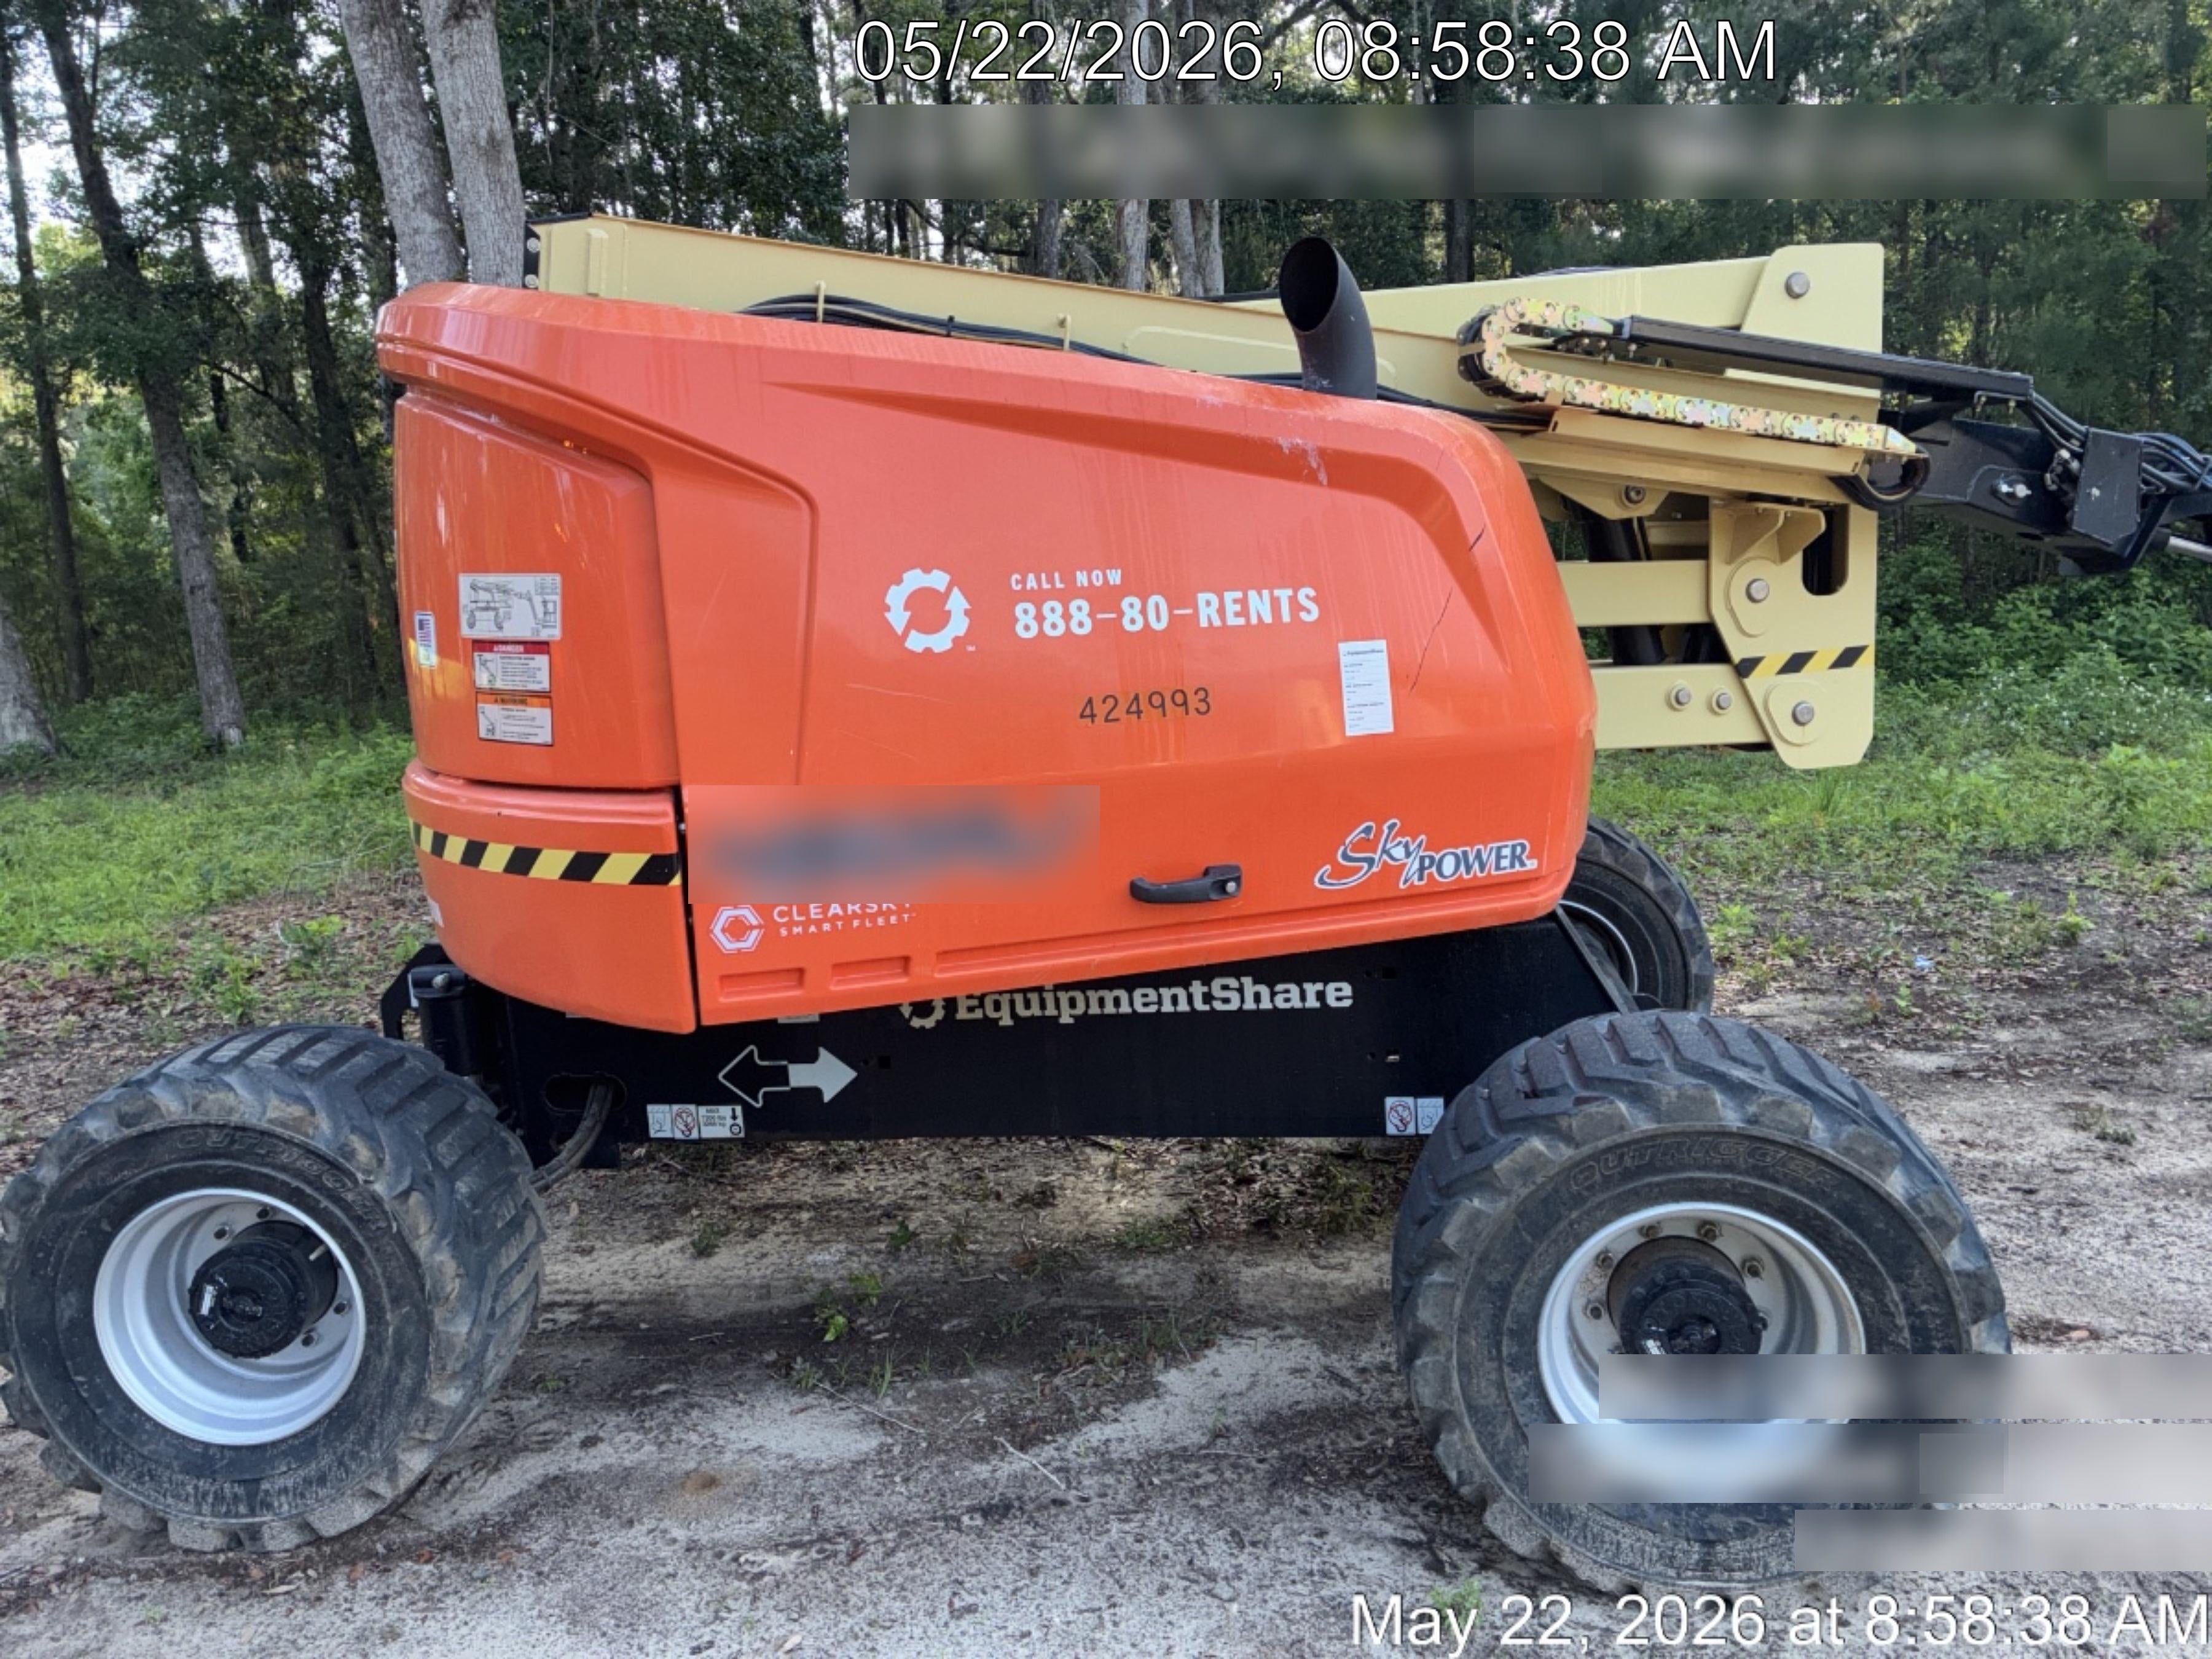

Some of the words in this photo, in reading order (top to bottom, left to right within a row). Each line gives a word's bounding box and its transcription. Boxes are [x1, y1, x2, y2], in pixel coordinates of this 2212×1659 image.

[1010, 572, 1065, 591] CALL
[1075, 568, 1123, 587] NOW
[1014, 587, 1320, 640] 888-80-RENTS
[1079, 686, 1211, 724] 424993
[773, 904, 911, 922] CLEARS
[779, 920, 844, 937] SMART
[852, 913, 911, 929] FLEET
[955, 976, 1354, 1026] EquipmentShare
[1569, 1135, 1843, 1192] OUTRIGGER
